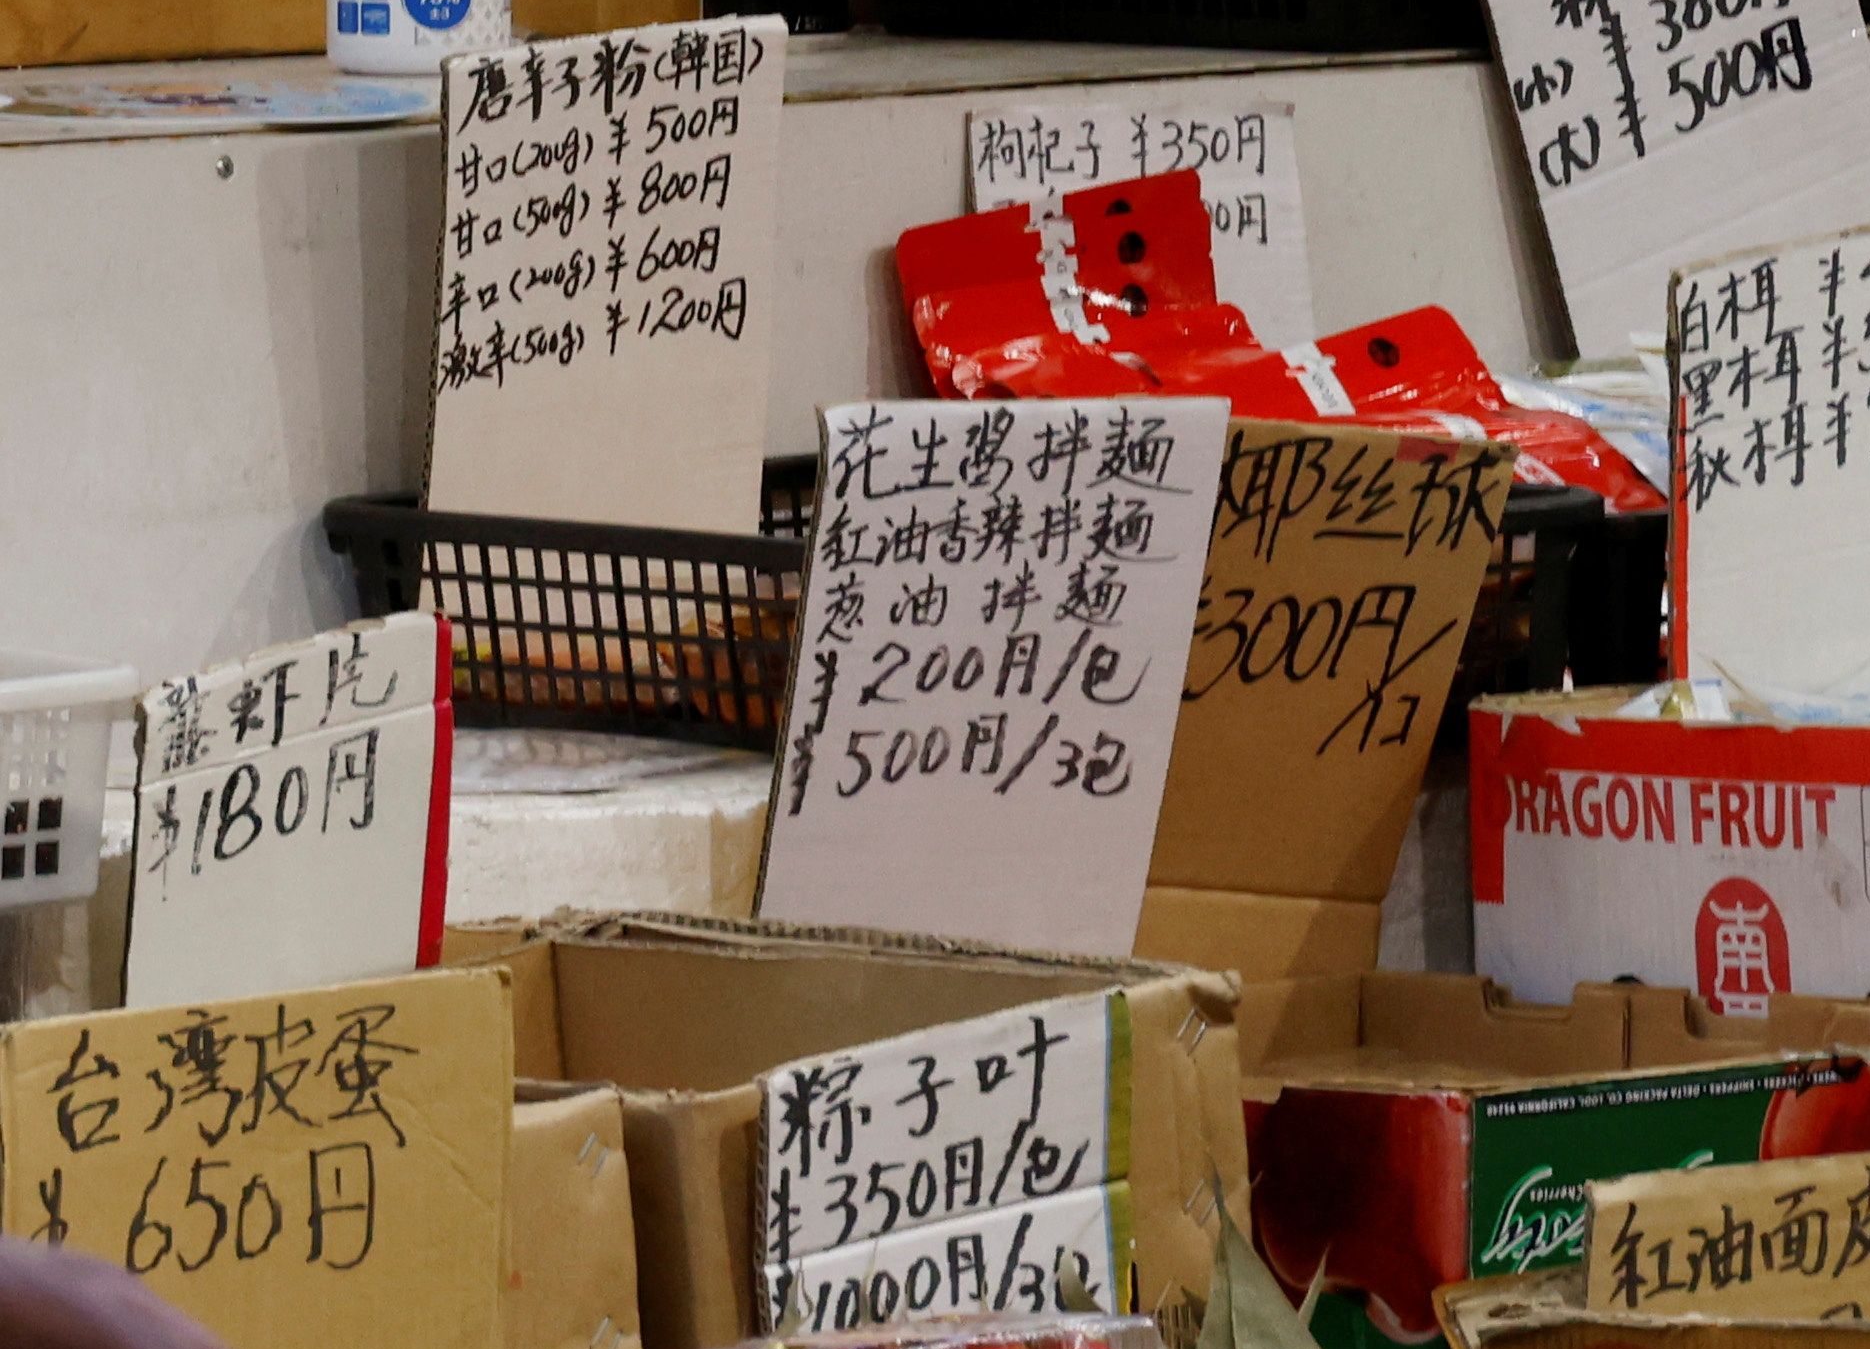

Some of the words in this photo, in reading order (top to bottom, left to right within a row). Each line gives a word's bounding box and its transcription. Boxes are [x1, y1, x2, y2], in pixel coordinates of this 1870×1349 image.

[606, 94, 740, 165] ¥500円
[1129, 112, 1267, 180] ¥350円
[602, 153, 732, 229] ¥800円
[604, 225, 722, 293] ¥600円
[604, 277, 748, 356] ¥1200円
[811, 626, 1153, 734] ¥200円/包
[788, 711, 1134, 818] ¥500円/3包
[145, 726, 378, 903] ¥180円
[1504, 773, 1676, 845] RAGON
[1689, 781, 1838, 851] FRUIT
[30, 1141, 377, 1276] ¥650円
[766, 1119, 1092, 1265] ¥350円/包
